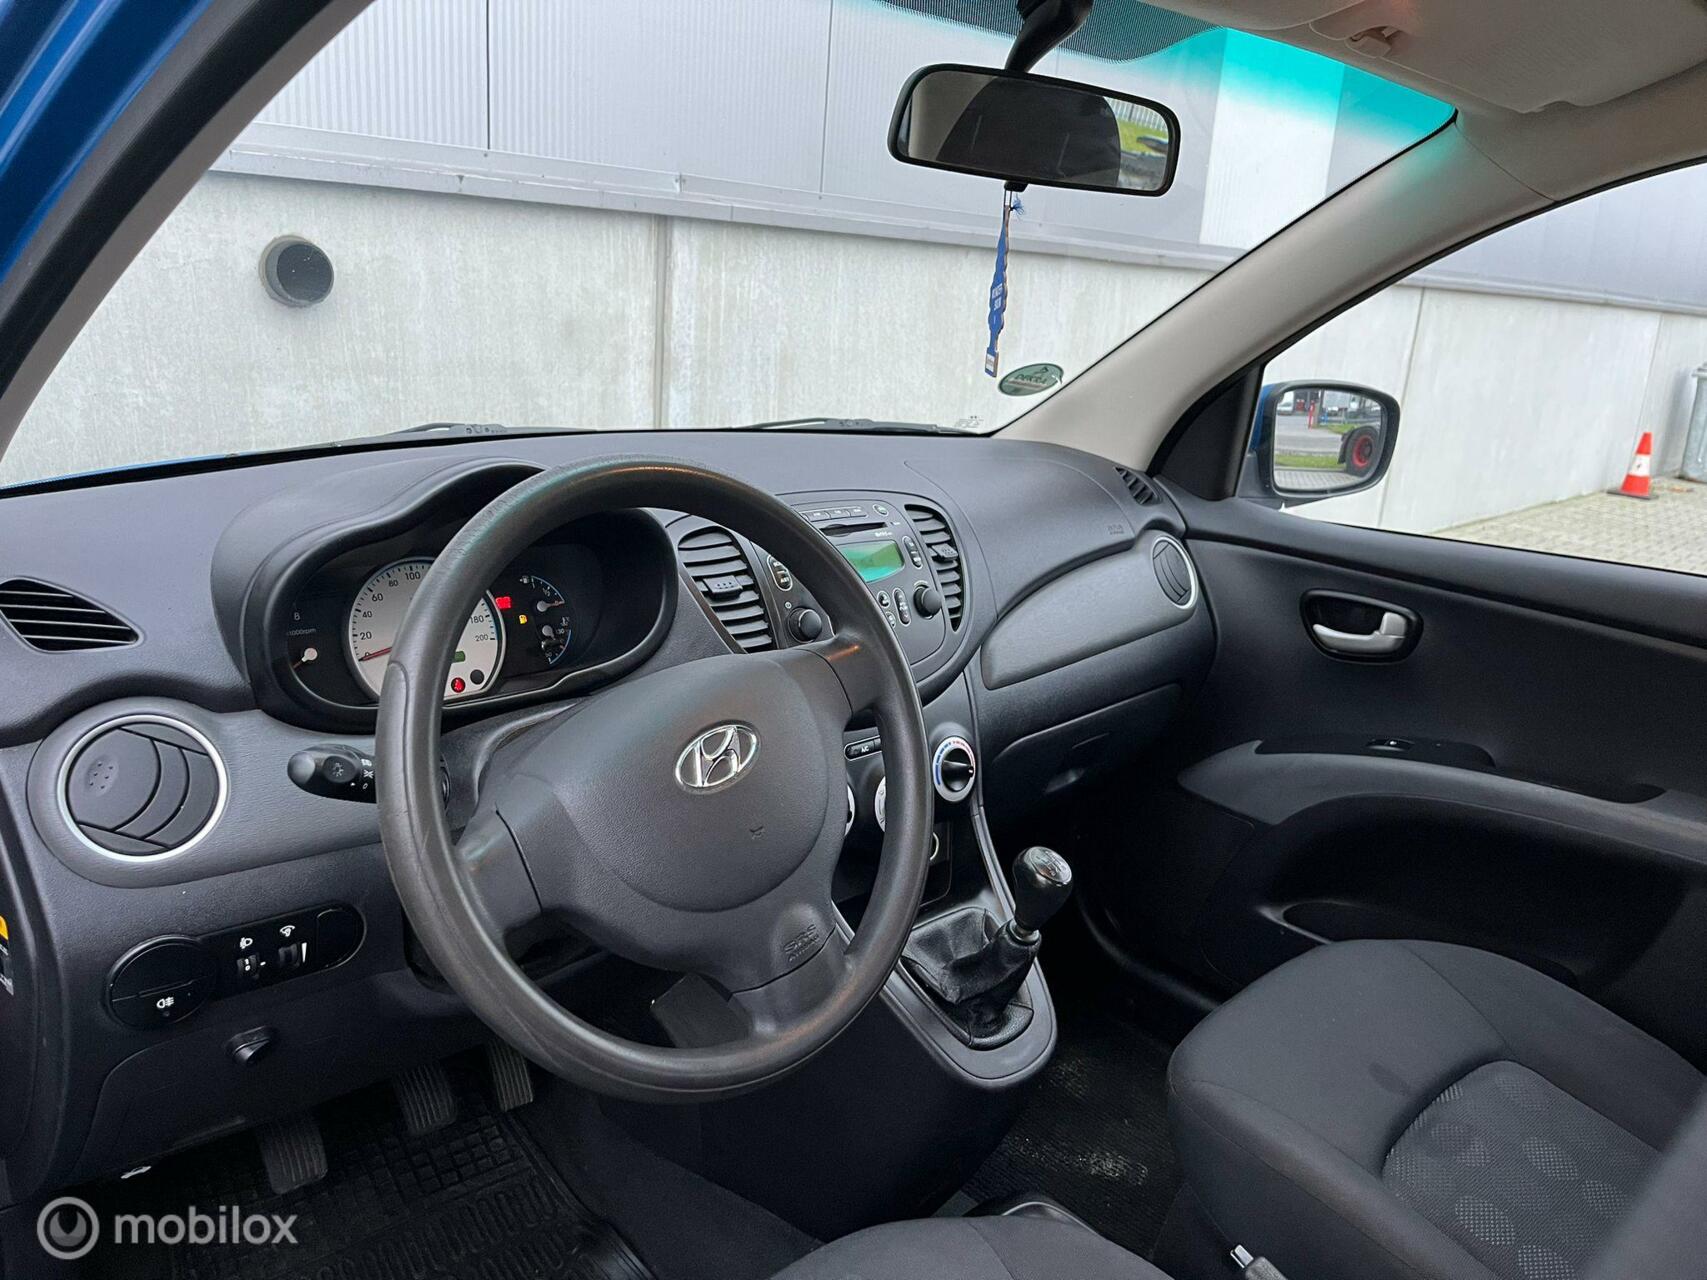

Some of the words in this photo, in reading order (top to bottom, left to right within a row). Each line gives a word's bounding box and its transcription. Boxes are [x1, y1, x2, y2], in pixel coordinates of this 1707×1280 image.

[405, 571, 421, 581] 100
[388, 579, 399, 587] 80
[371, 592, 384, 602] 60
[362, 610, 373, 618] 40
[470, 615, 484, 624] 180
[359, 631, 373, 641] 20
[474, 633, 489, 642] 200
